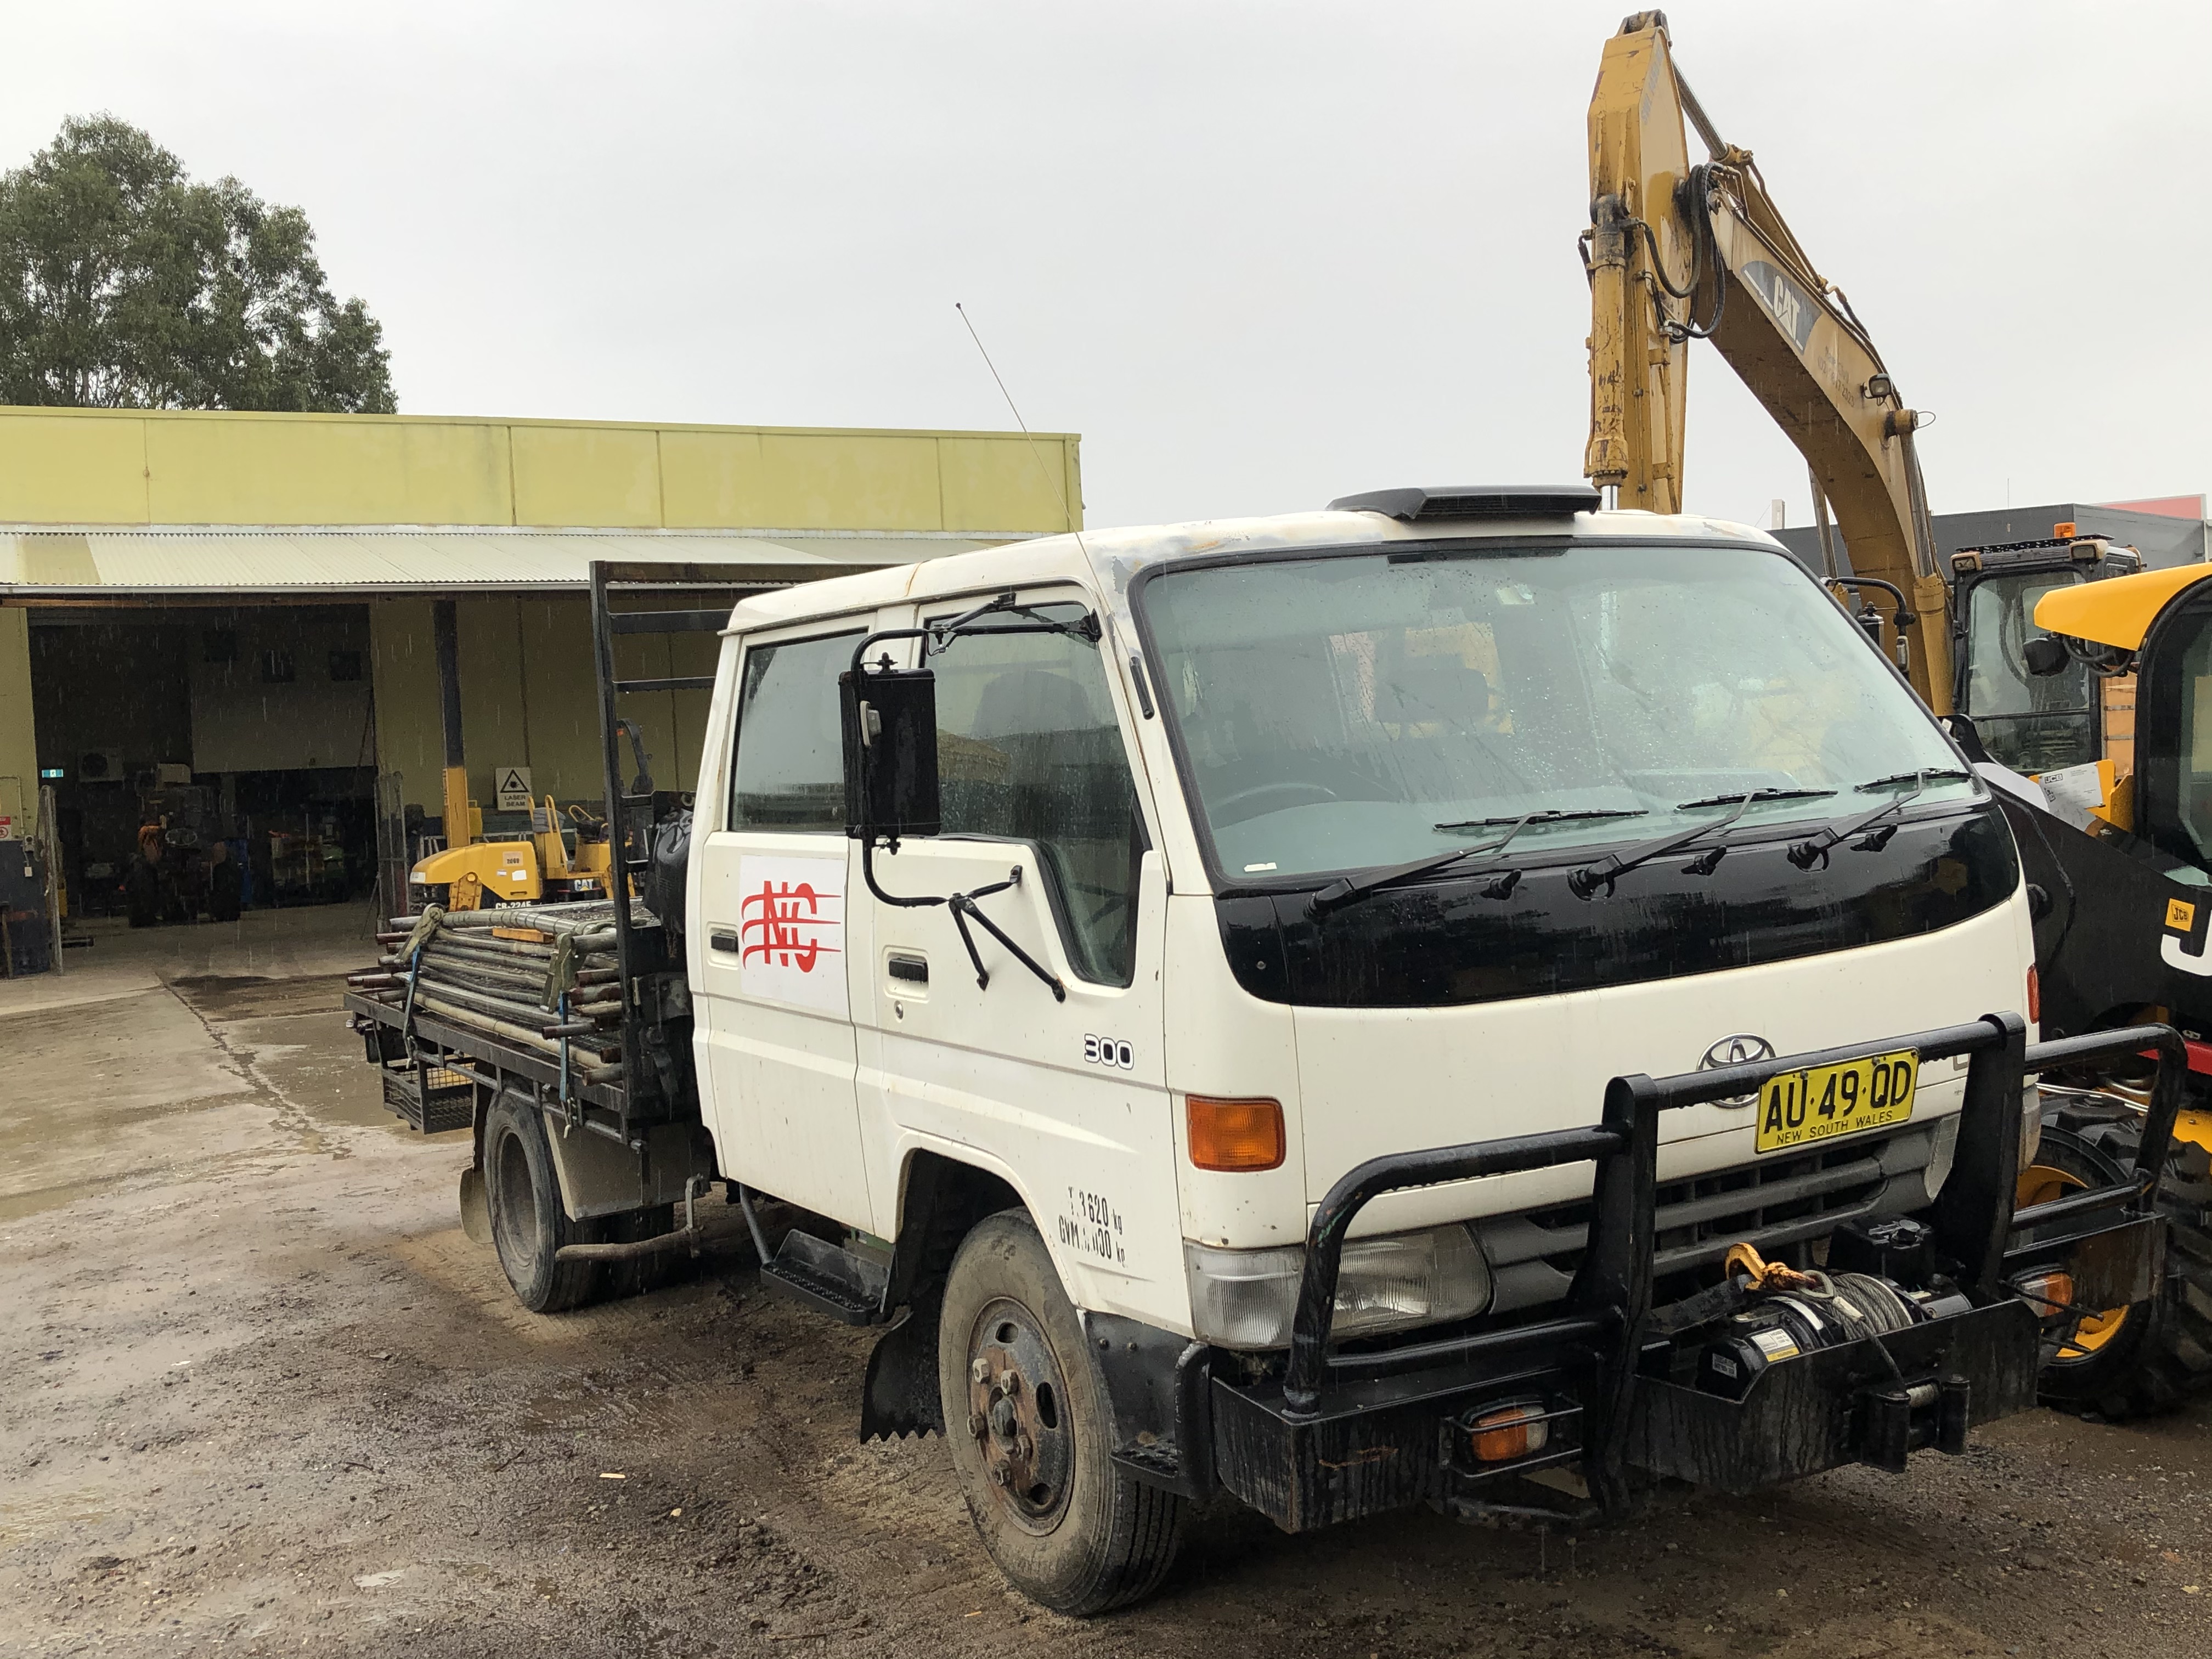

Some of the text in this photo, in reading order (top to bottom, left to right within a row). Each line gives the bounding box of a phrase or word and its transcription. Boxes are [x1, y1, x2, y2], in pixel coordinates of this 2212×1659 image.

[1774, 275, 1800, 340] CAT
[2045, 774, 2063, 784] JCB
[574, 879, 594, 891] CAT
[2174, 907, 2188, 920] JCB
[1084, 1034, 1134, 1070] 300
[1776, 1110, 1893, 1145] NEW SOUTH WALES
[1113, 1208, 1122, 1235] kg
